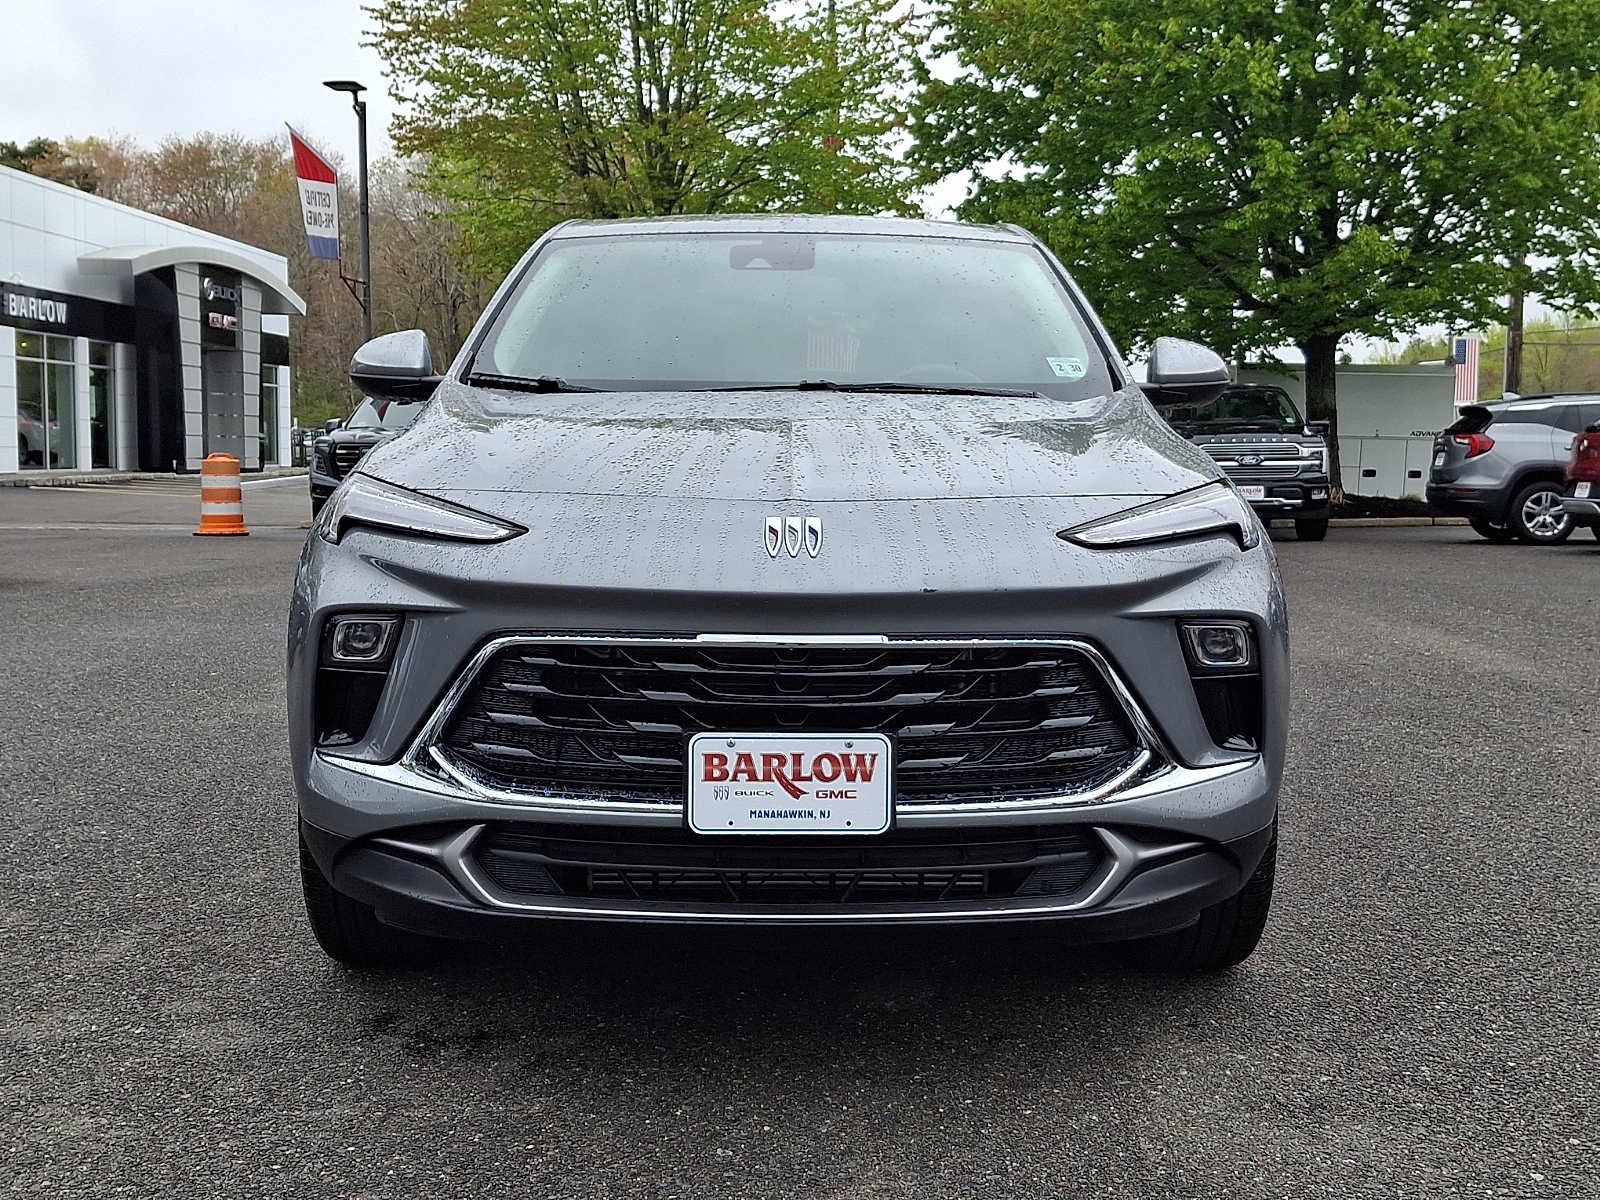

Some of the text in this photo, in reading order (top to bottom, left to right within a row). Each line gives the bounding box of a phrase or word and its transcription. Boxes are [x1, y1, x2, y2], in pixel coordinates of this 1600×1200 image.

[8, 293, 67, 324] BARLOW
[701, 752, 879, 799] BARLOW
[815, 789, 857, 799] GMC
[749, 809, 831, 820] MANAHAWKIN, NJ
